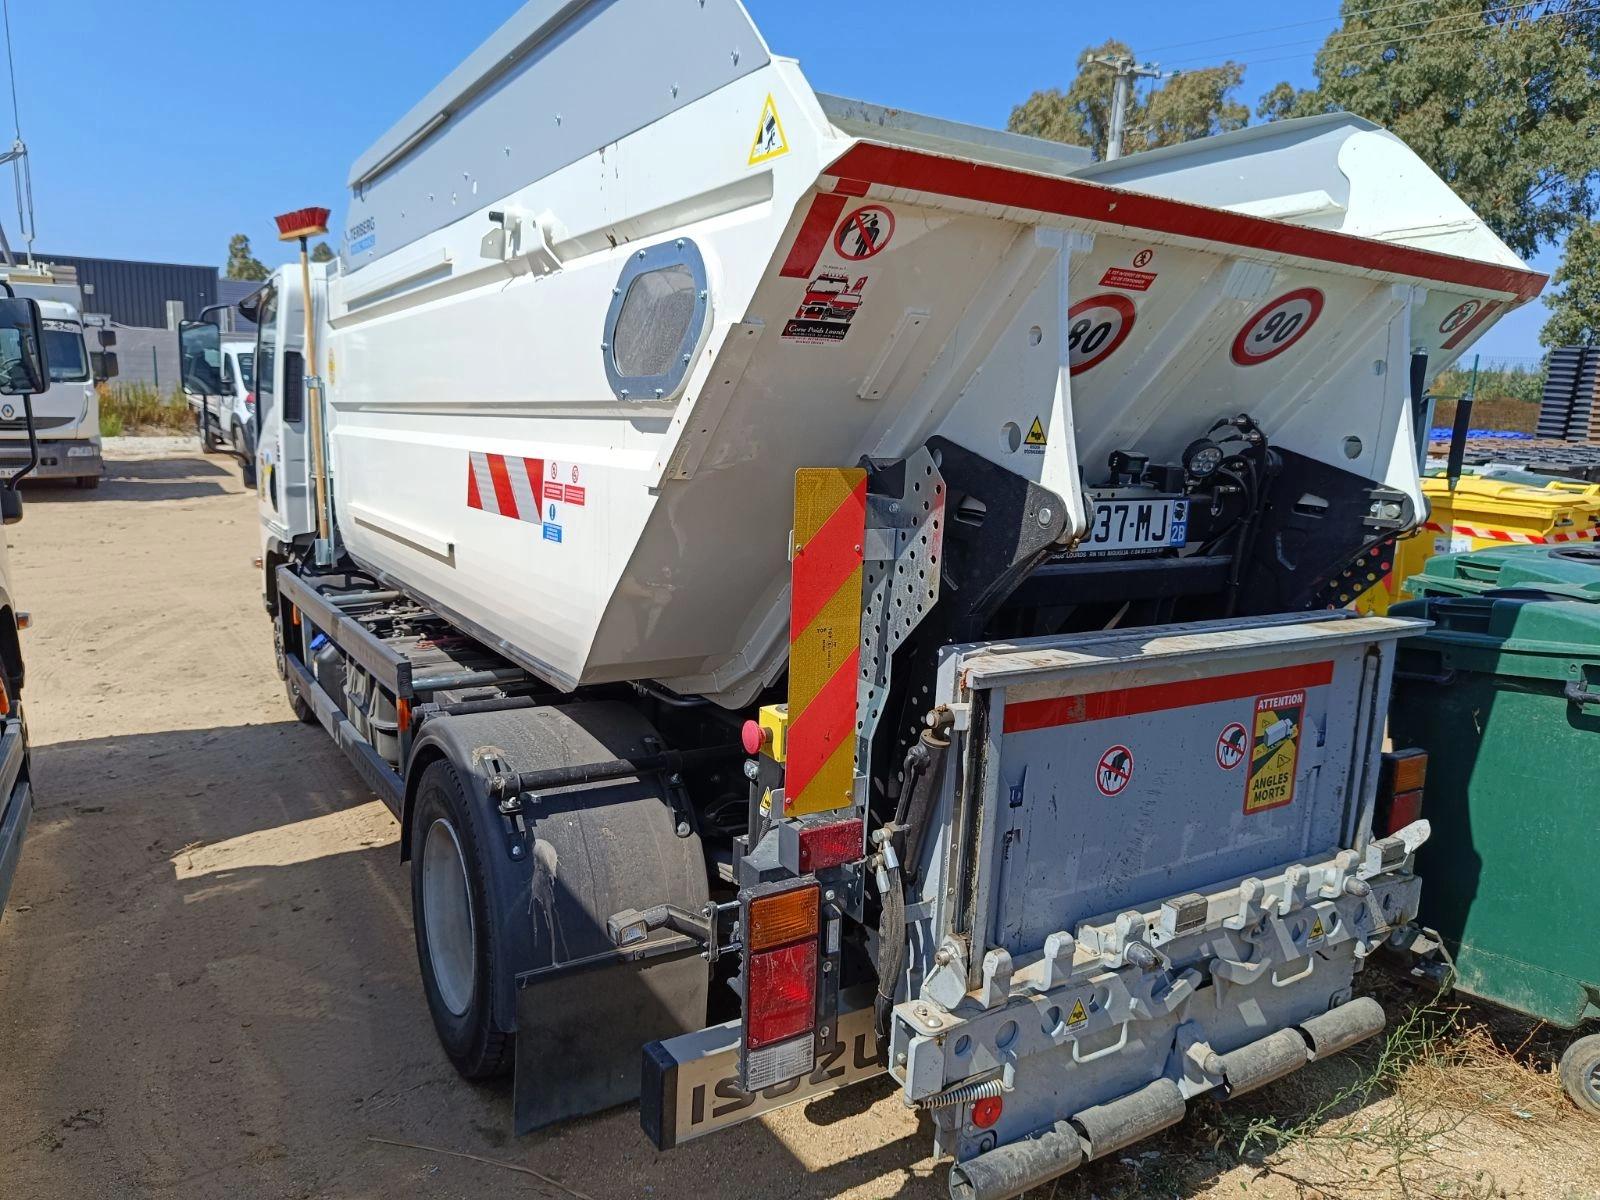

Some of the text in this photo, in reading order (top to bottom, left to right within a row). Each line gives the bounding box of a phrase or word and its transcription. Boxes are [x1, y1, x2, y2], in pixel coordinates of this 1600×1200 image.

[807, 326, 824, 334] Poids
[1068, 318, 1112, 354] 80
[1254, 311, 1304, 344] 90
[1081, 504, 1168, 543] 37-MJ
[1171, 525, 1186, 543] 2B
[1257, 693, 1304, 711] ATTENTION
[1252, 772, 1289, 791] ANGLES
[1253, 785, 1286, 803] MORTS
